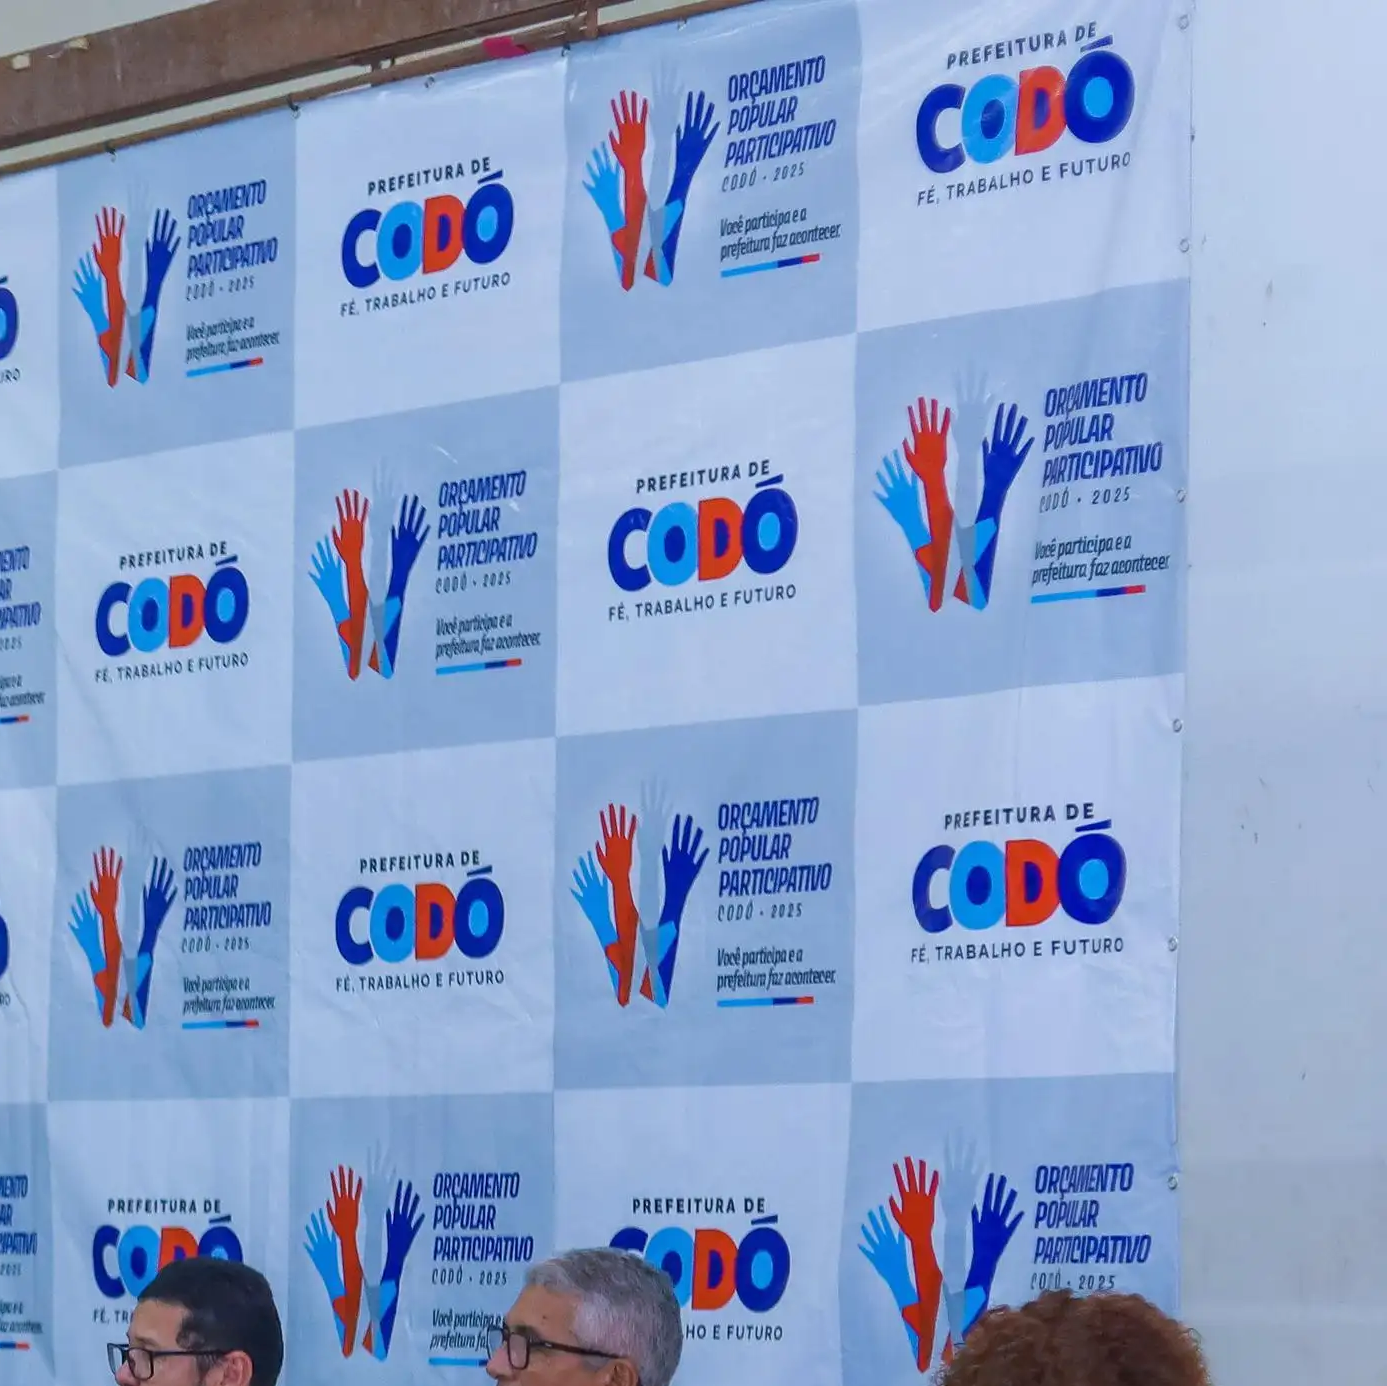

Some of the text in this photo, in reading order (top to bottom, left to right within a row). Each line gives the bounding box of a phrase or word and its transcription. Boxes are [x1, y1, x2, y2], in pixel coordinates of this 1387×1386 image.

[947, 20, 1097, 70] PREFEITURA DE
[728, 55, 826, 104] ORÇAMENTO
[727, 96, 798, 135] POPULAR
[916, 34, 1135, 173] CODÓ
[724, 119, 836, 168] PARTICIPATIVO
[368, 156, 491, 196] PREFEITURA DE
[946, 169, 1034, 200] TRABALHO
[1041, 165, 1052, 182] E
[1059, 151, 1131, 179] FUTURO
[341, 170, 514, 288] CODÓ
[365, 286, 437, 312] TRABALHO
[442, 284, 449, 298] E
[454, 272, 510, 295] FUTURO
[1044, 372, 1148, 418] ORÇAMENTO
[1044, 413, 1115, 452] POPULAR
[636, 459, 769, 494] PREFEITURA DE
[1042, 443, 1162, 488] PARTICIPATIVO
[439, 470, 526, 510] ORÇAMENTO
[438, 505, 502, 539] POPULAR
[607, 474, 799, 592] CODÓ
[120, 541, 227, 569] PREFEITURA DE
[437, 531, 538, 571] PARTICIPATIVO
[96, 555, 249, 656] CODÓ
[635, 595, 715, 617] TRABALHO
[720, 592, 728, 608] E
[734, 584, 797, 605] FUTURO
[117, 660, 183, 680] TRABALHO
[186, 659, 193, 672] E
[198, 652, 249, 671] FUTURO
[719, 796, 819, 835] ORÇAMENTO
[944, 802, 1094, 830] PREFEITURA DE
[184, 841, 262, 875] ORÇAMENTO
[360, 850, 480, 873] PREFEITURA DE
[718, 833, 791, 864] POPULAR
[184, 874, 238, 902] POPULAR
[718, 864, 832, 898] PARTICIPATIVO
[912, 819, 1127, 934] CODÓ
[183, 901, 271, 931] PARTICIPATIVO
[335, 865, 505, 965] CODÓ
[935, 942, 1025, 962] TRABALHO
[1033, 941, 1042, 957] E
[1050, 938, 1124, 955] FUTURO
[359, 974, 430, 990] TRABALHO
[436, 972, 442, 988] E
[448, 969, 505, 985] FUTURO
[433, 1172, 520, 1204] ORÇAMENTO
[1035, 1163, 1134, 1199] ORÇAMENTO
[107, 1199, 221, 1214] PREFEITURA DE
[433, 1204, 497, 1230] POPULAR
[633, 1198, 764, 1213] PREFEITURA DE
[1034, 1200, 1099, 1229] POPULAR
[432, 1235, 534, 1261] PARTICIPATIVO
[1034, 1234, 1149, 1265] PARTICIPATIVO
[713, 1324, 720, 1339] E
[726, 1324, 783, 1340] FUTURO
